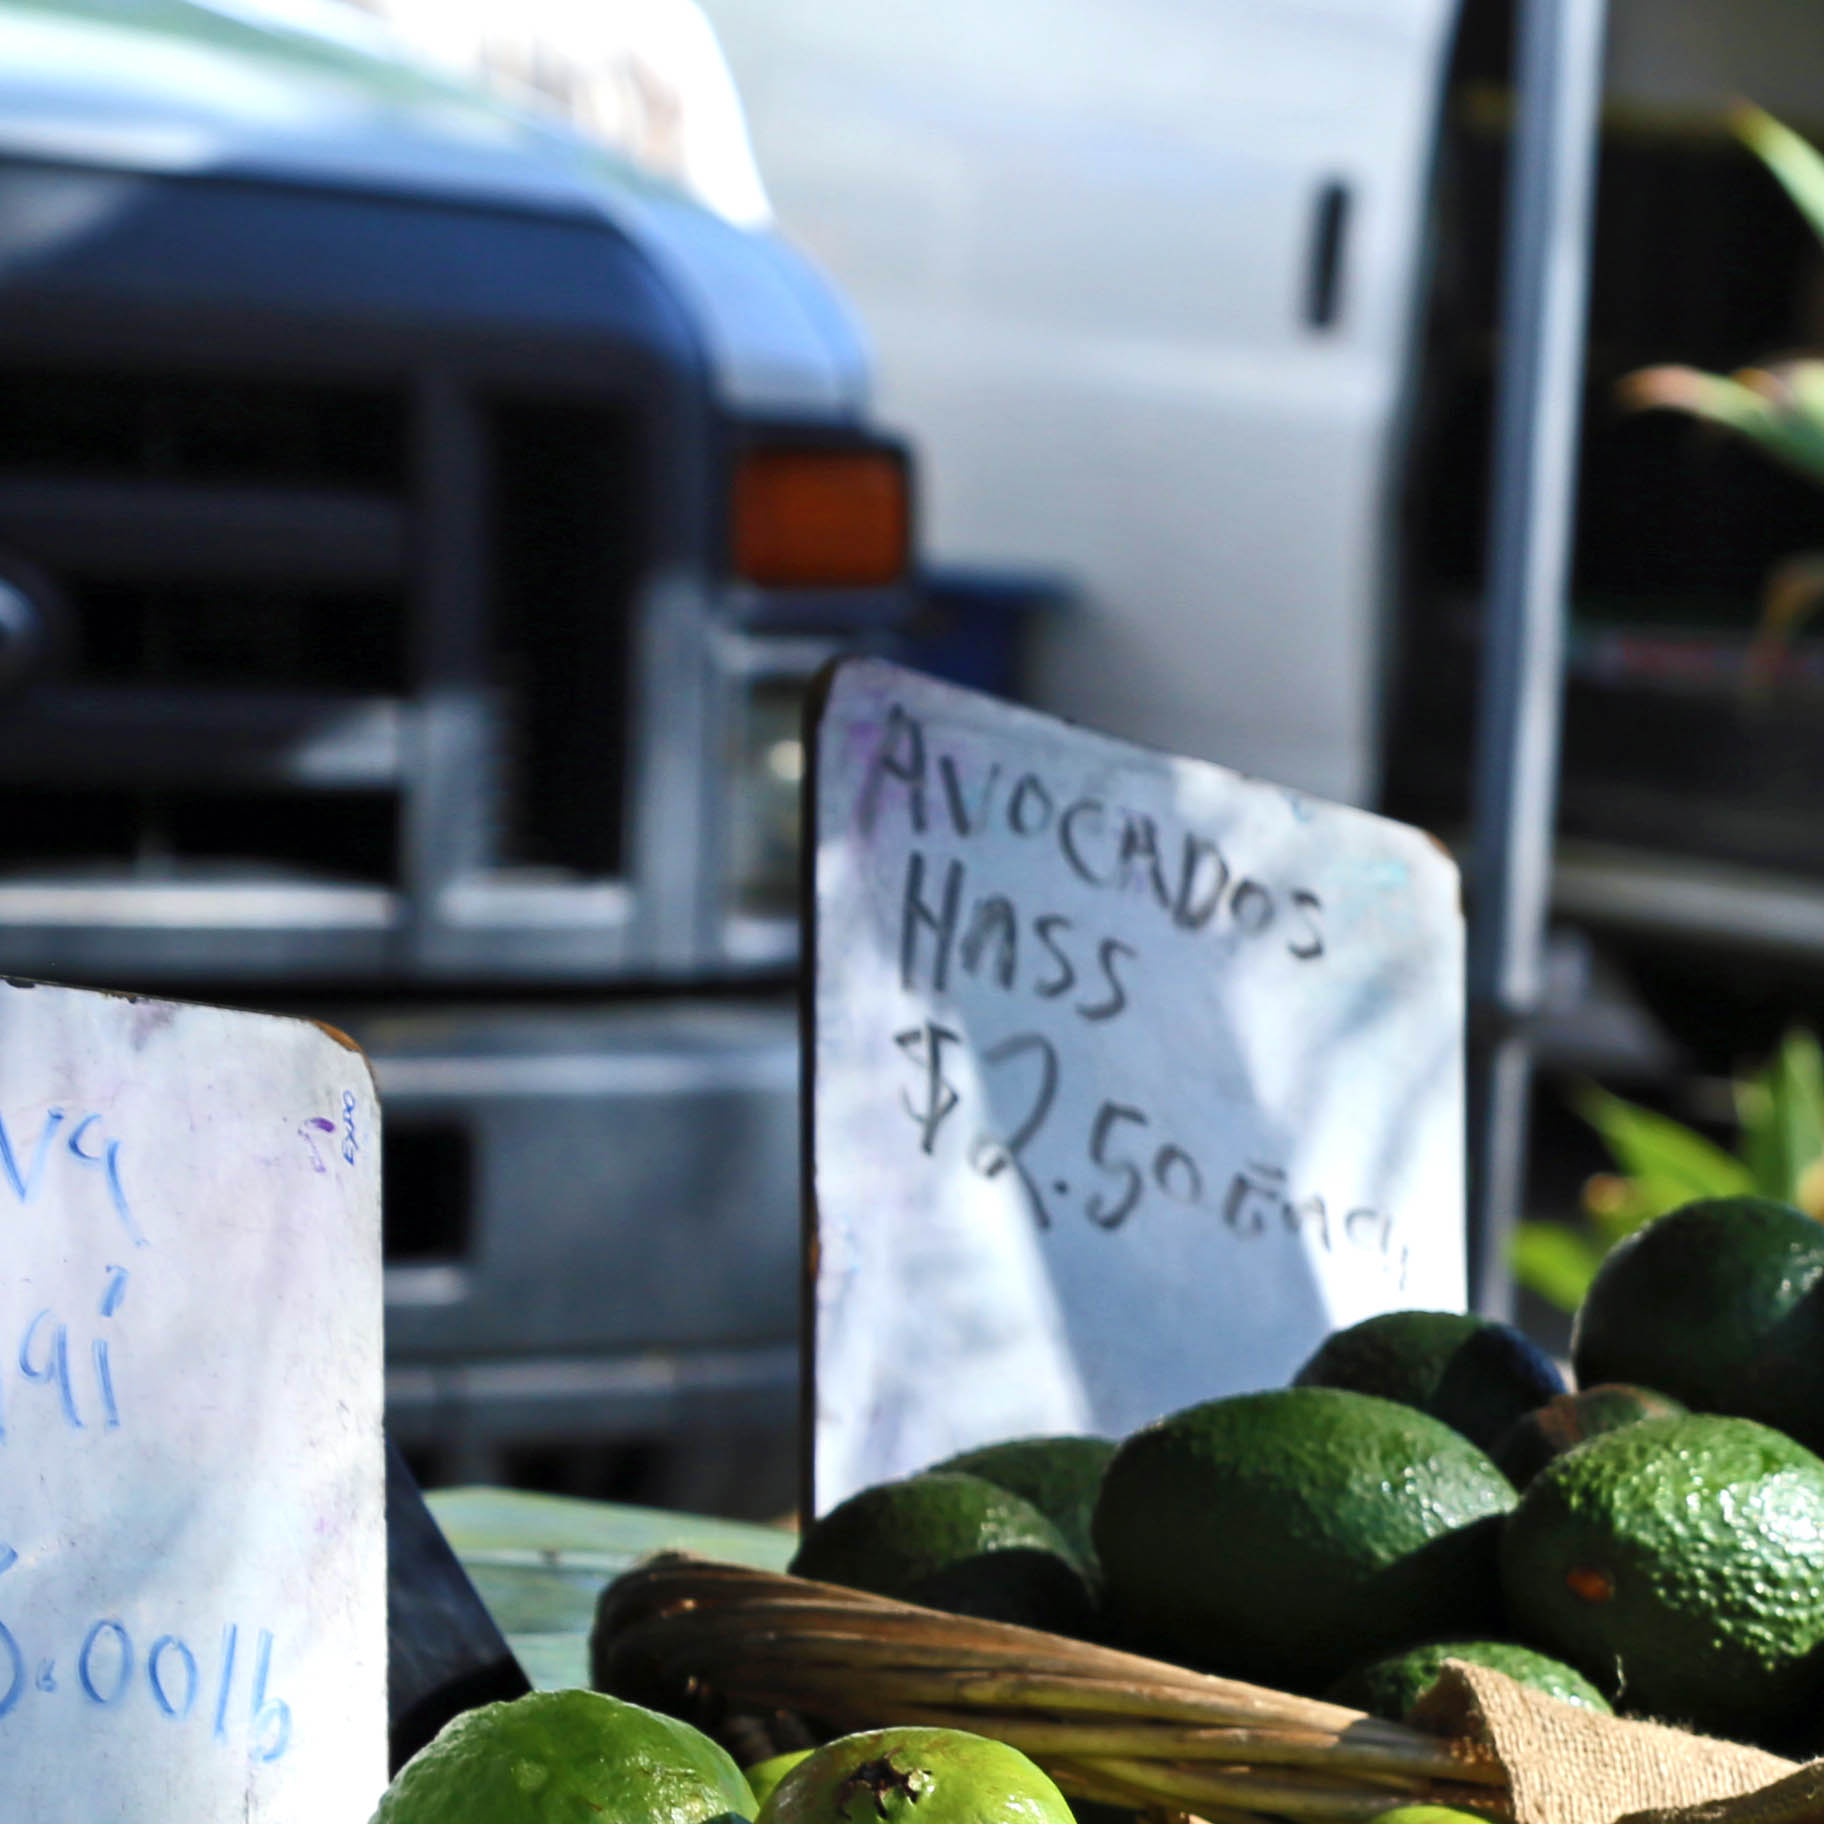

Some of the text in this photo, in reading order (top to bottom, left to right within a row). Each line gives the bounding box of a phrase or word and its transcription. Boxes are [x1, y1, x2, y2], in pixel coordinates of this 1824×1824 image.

[857, 704, 1324, 962] AVOCADOS
[900, 849, 1137, 1022] HASS
[893, 1022, 1200, 1234] $2.50
